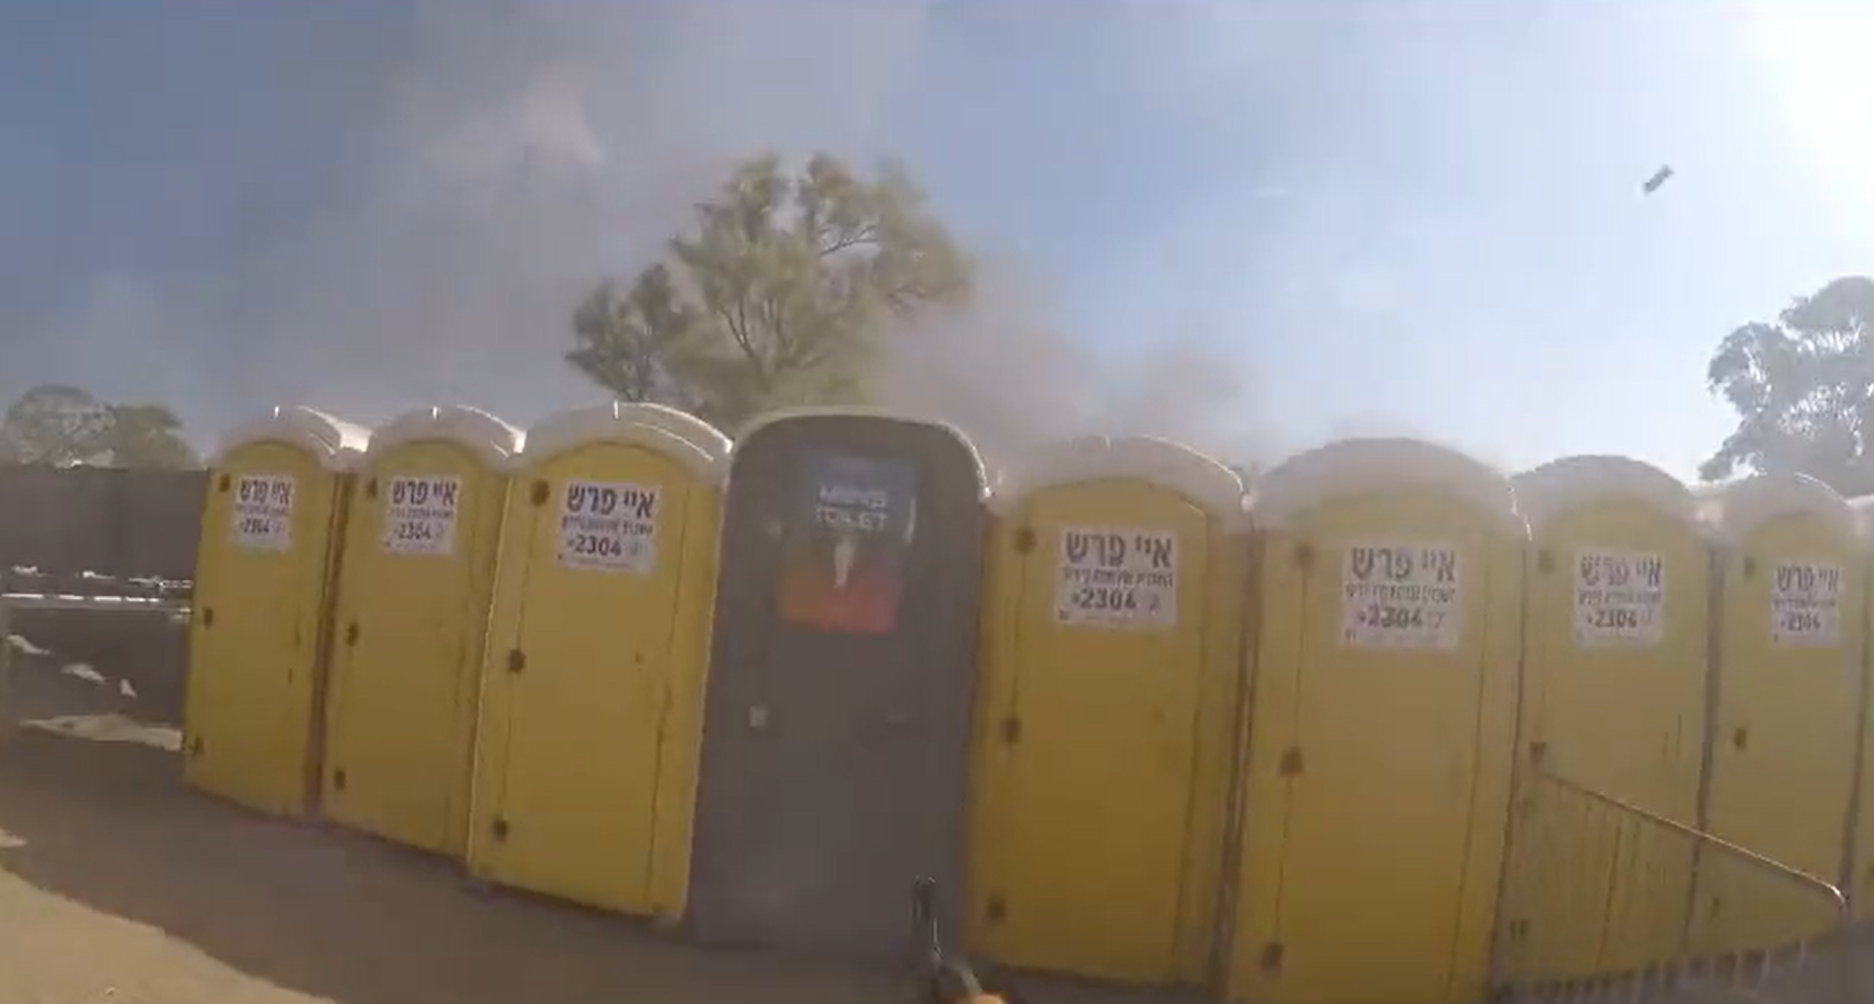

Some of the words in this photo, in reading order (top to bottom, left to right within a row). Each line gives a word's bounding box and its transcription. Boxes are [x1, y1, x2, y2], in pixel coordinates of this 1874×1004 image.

[567, 485, 616, 515] פרש
[624, 489, 655, 518] איי
[1066, 532, 1126, 567] פרש
[1135, 535, 1172, 568] איי
[1351, 547, 1412, 581] פרש
[1422, 548, 1456, 583] איי
